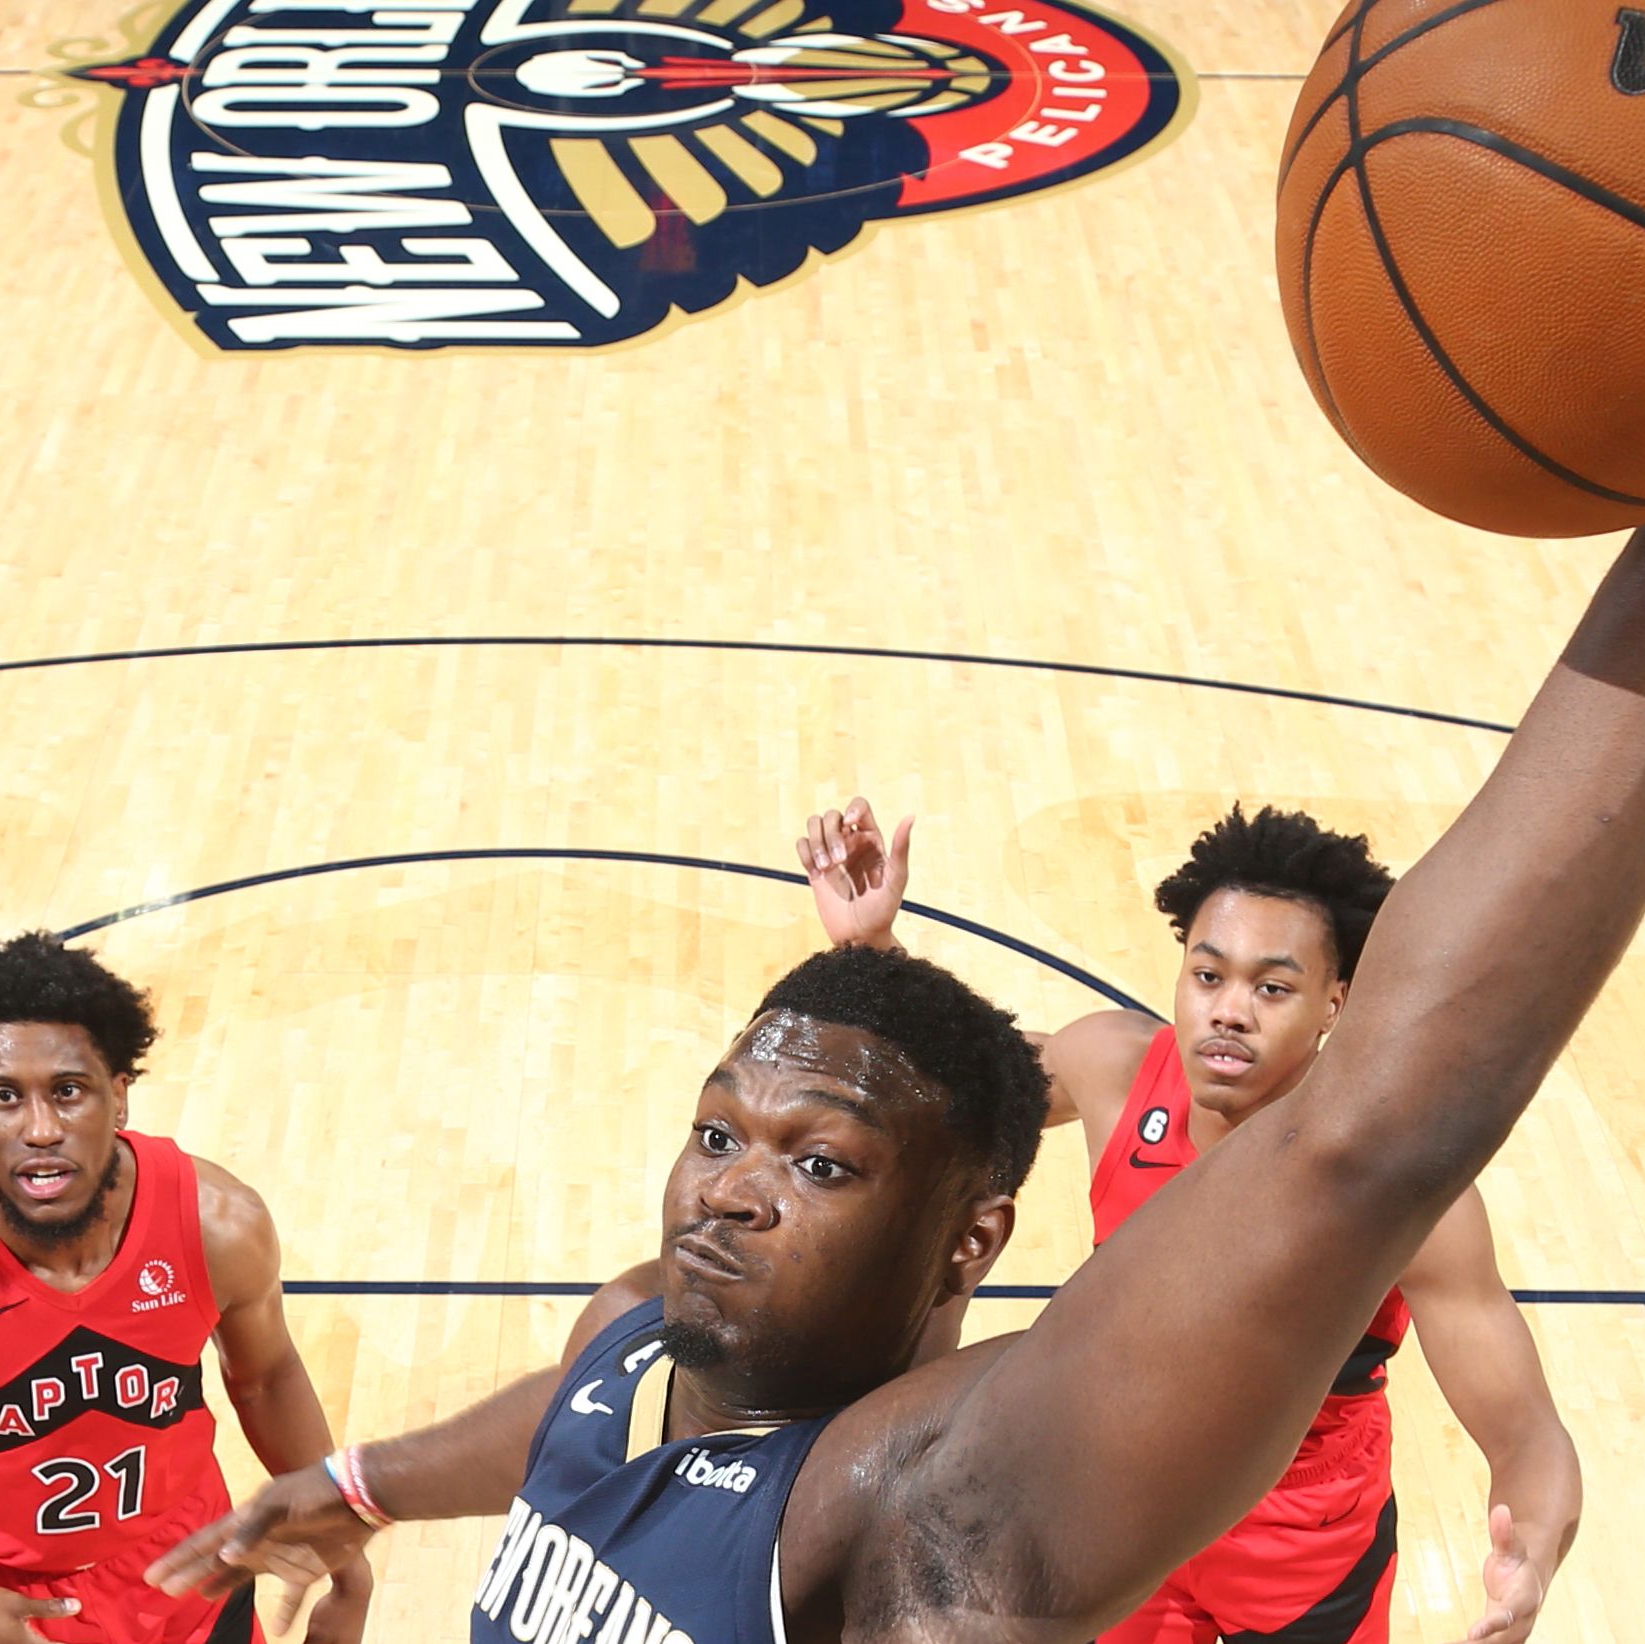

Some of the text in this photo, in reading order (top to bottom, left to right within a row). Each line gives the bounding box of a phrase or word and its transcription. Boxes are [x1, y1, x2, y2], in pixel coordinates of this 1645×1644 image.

[191, 151, 582, 343] NEW
[1143, 1110, 1168, 1142] 6
[131, 1292, 187, 1313] Sun Life
[32, 1445, 146, 1534] 21
